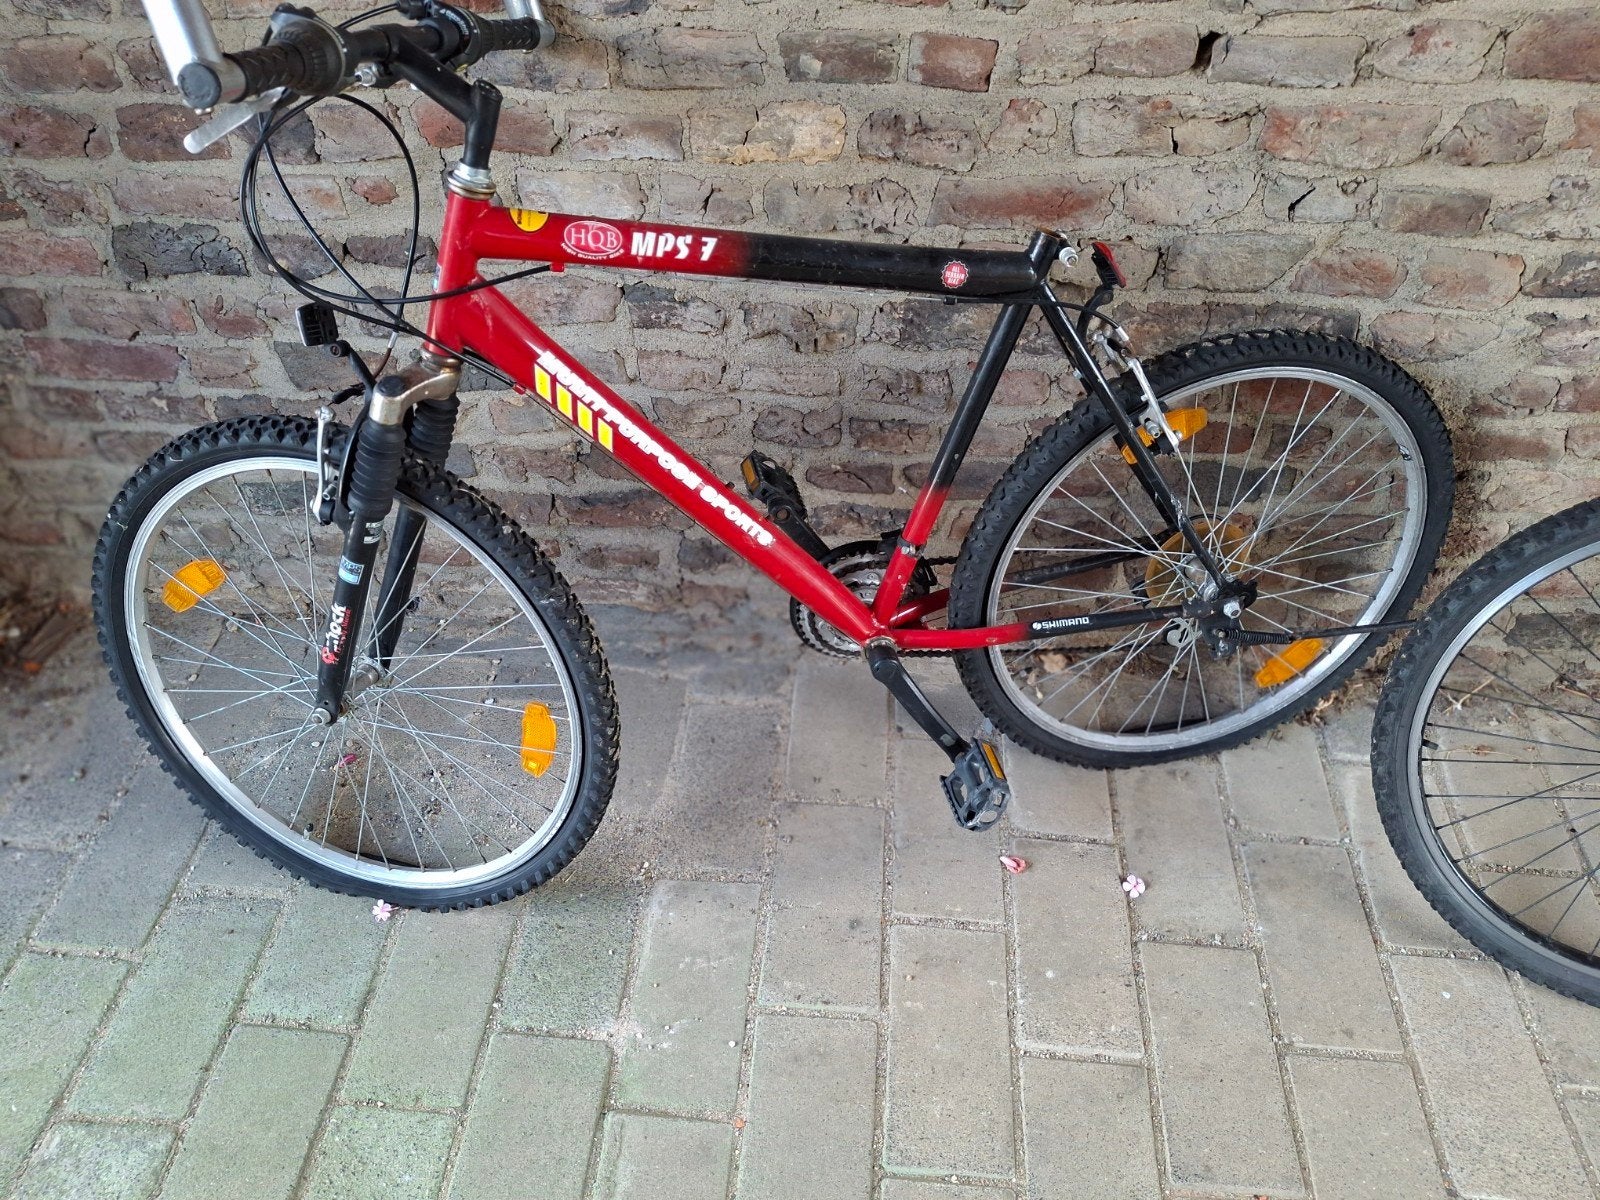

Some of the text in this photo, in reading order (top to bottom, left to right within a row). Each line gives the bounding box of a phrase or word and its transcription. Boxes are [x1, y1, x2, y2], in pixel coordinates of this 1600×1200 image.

[561, 242, 577, 256] HIGH
[569, 227, 618, 252] HQB
[630, 231, 719, 262] MPS 7
[699, 485, 775, 547] SPORTS
[1041, 616, 1090, 629] SHIMANO
